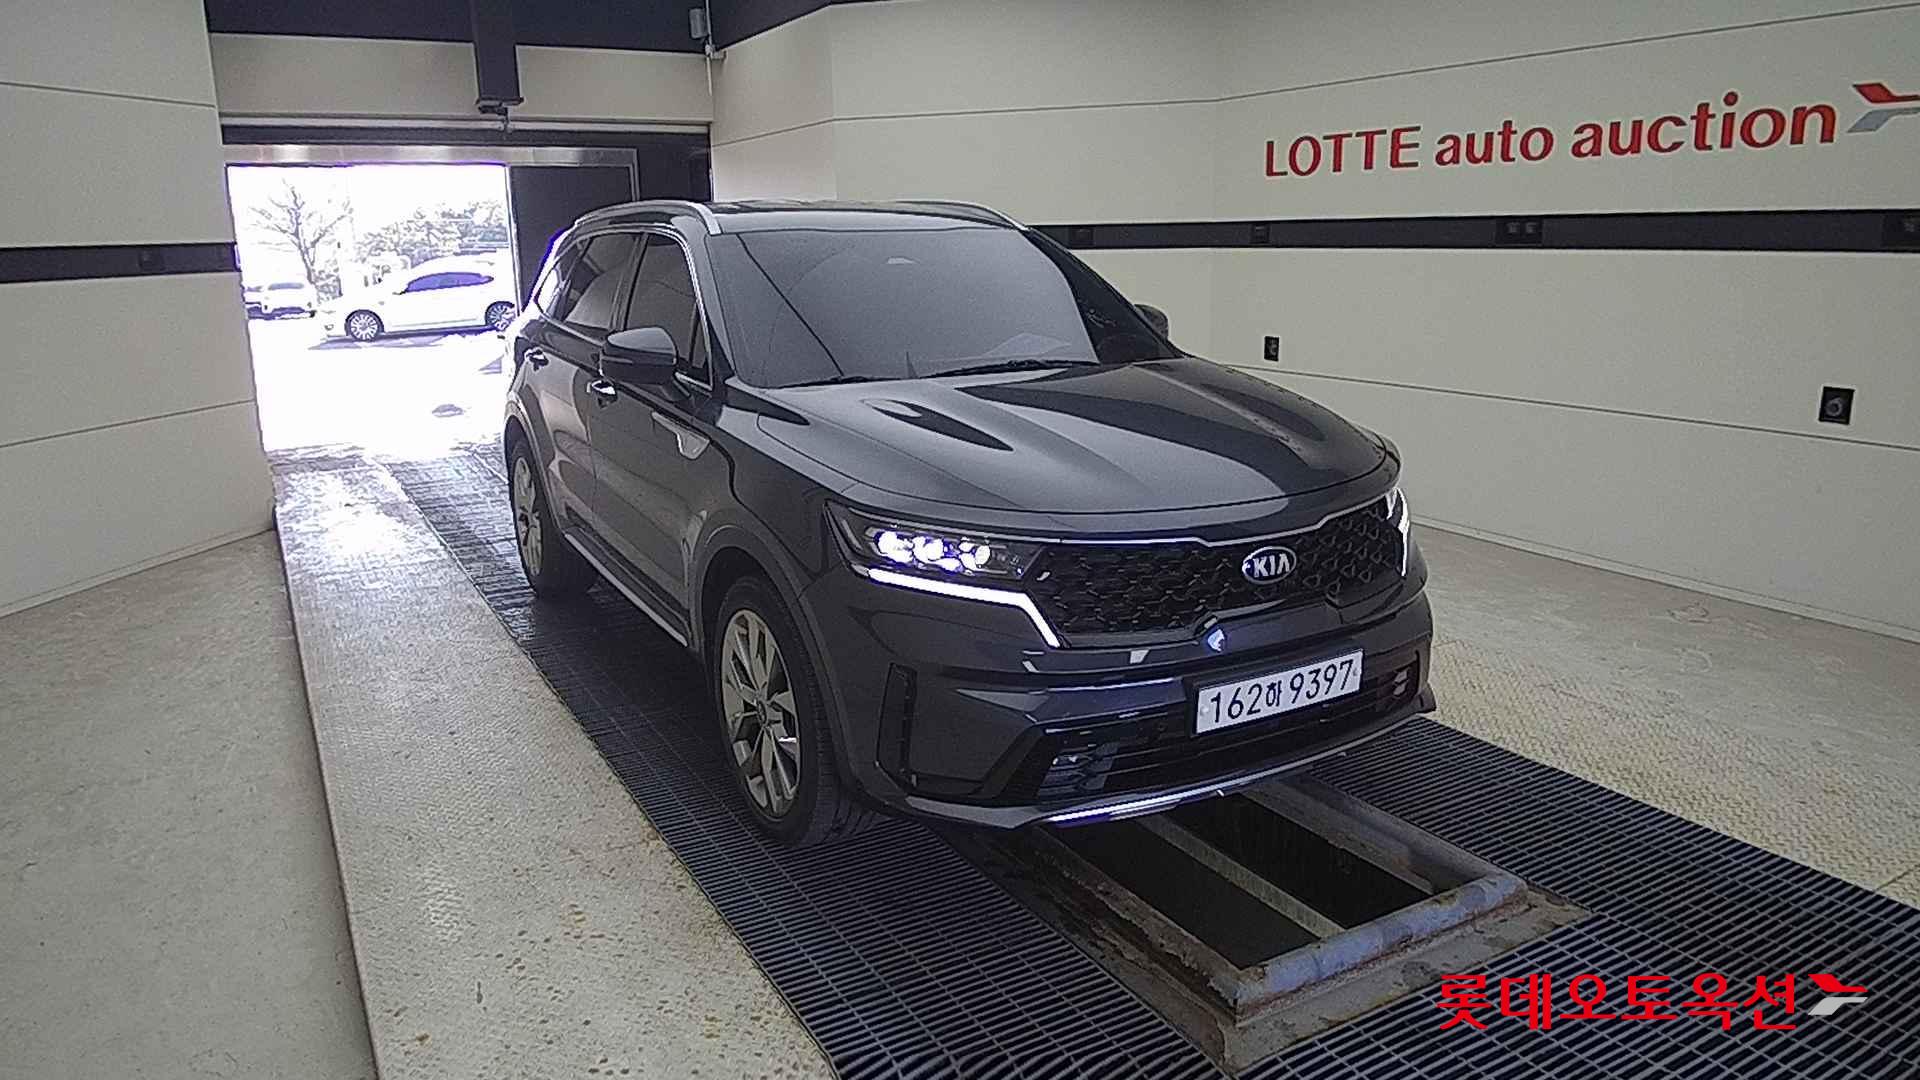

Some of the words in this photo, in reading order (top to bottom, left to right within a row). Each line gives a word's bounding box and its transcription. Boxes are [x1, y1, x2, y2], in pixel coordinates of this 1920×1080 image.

[1265, 125, 1421, 177] LOTTE
[1434, 119, 1554, 166] auto
[1570, 91, 1837, 158] auction
[1252, 553, 1290, 578] KIA
